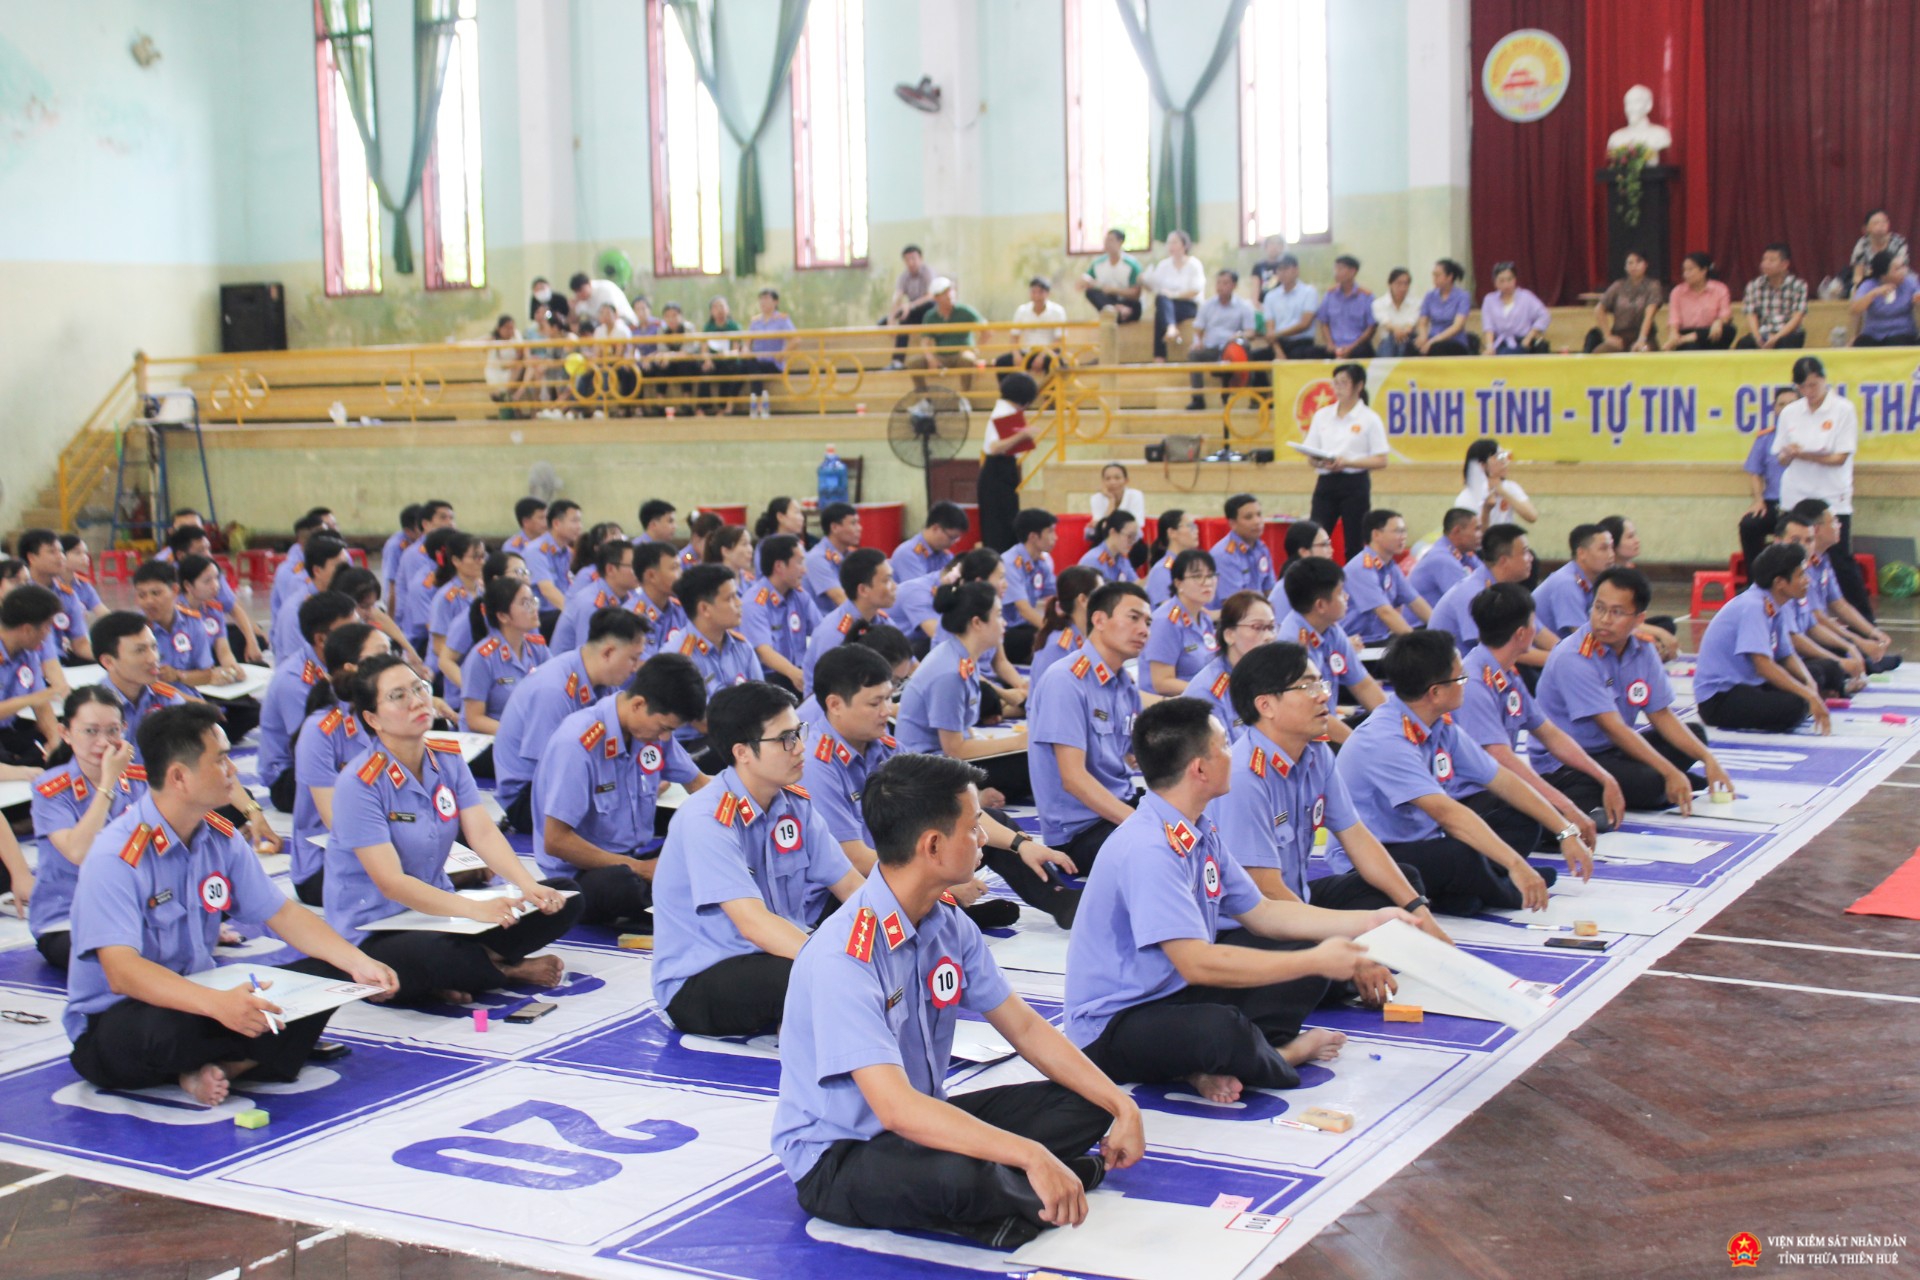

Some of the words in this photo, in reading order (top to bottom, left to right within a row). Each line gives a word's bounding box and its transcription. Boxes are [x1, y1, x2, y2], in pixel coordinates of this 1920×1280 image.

[1388, 380, 1464, 435] BÌNH
[1475, 379, 1551, 435] TĨNH
[1587, 381, 1633, 445] TỰ
[1640, 386, 1696, 434] TIN
[643, 750, 657, 765] 28
[779, 824, 795, 841] 19
[1206, 867, 1216, 884] 09
[209, 883, 223, 899] 30
[937, 971, 953, 992] 10
[392, 1100, 699, 1190] 20
